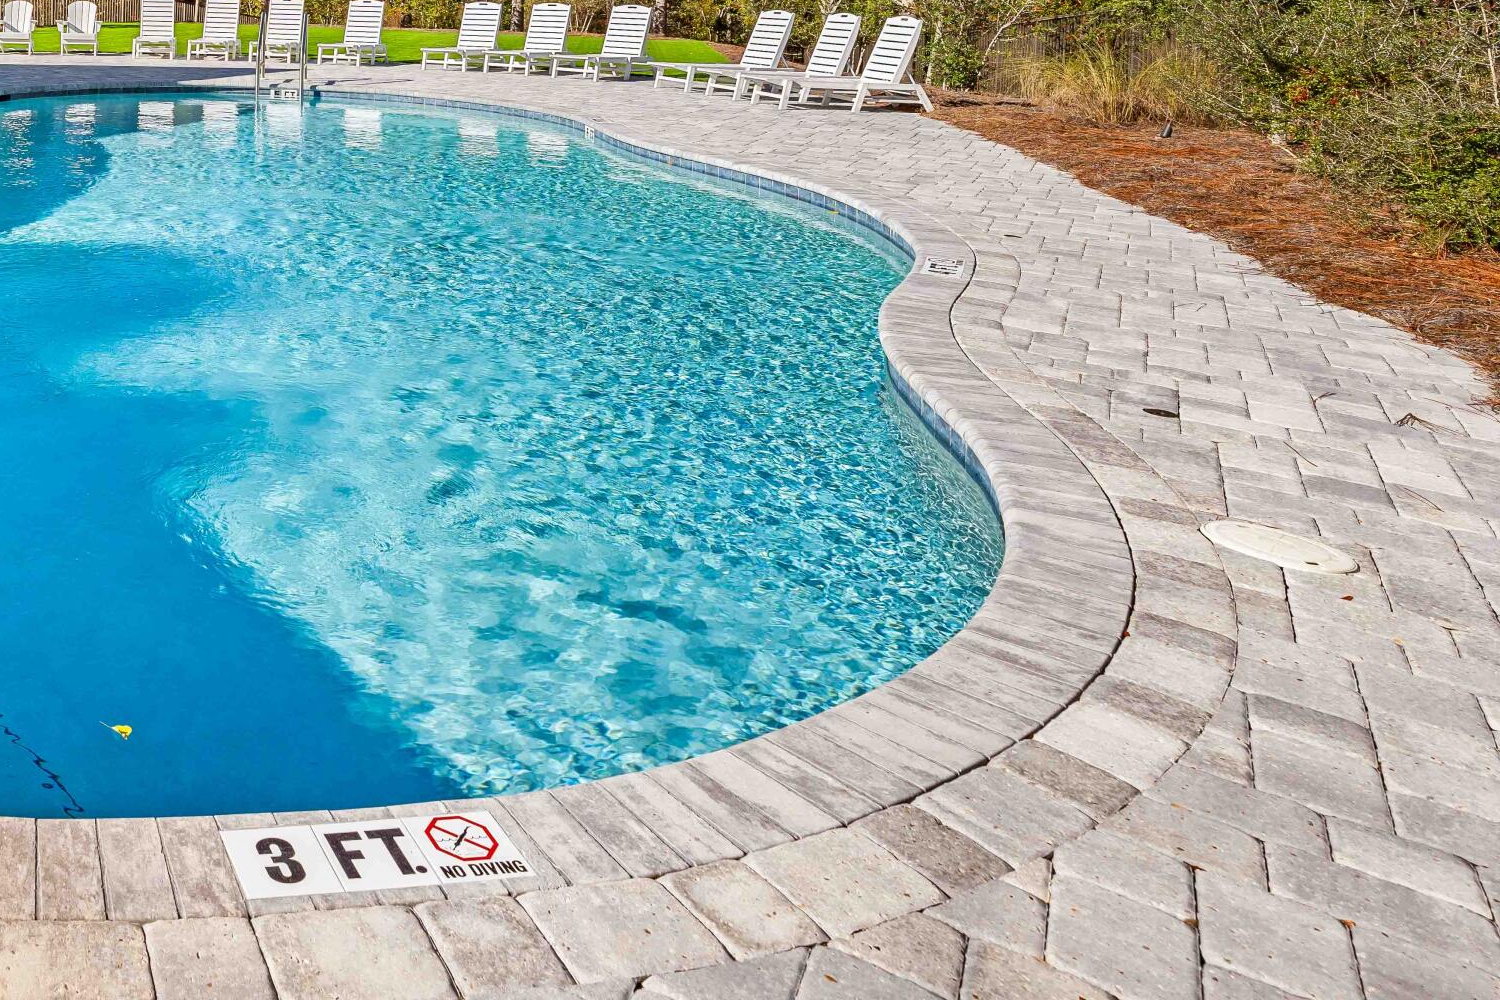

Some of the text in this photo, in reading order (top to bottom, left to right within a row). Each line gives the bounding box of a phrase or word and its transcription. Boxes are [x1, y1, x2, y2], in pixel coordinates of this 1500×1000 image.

[255, 827, 429, 884] 3 FT.
[439, 860, 529, 879] NO DIVING
